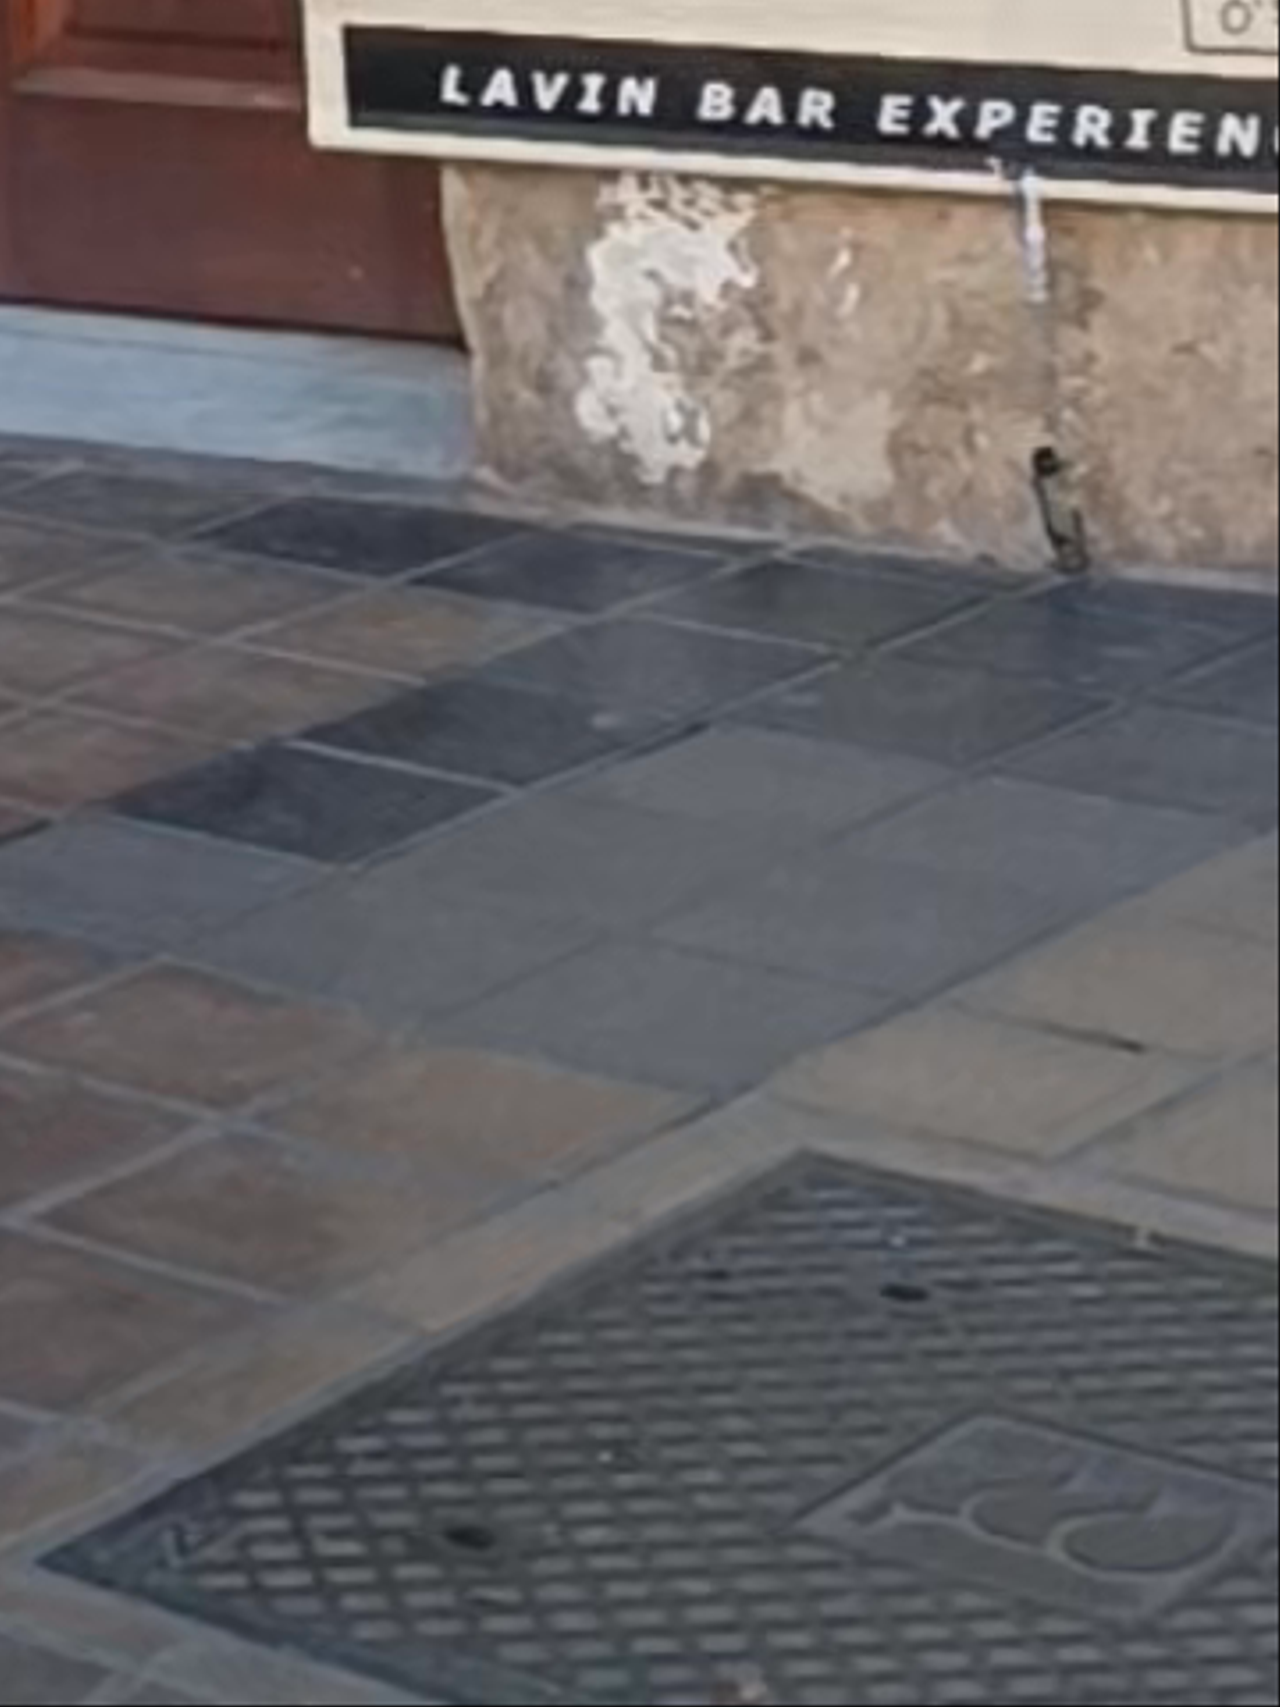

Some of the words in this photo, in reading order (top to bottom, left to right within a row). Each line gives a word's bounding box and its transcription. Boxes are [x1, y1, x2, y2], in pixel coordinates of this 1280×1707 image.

[440, 64, 657, 118] LAVIN
[695, 80, 836, 131] BAR
[877, 92, 1278, 158] EXPERIEN
